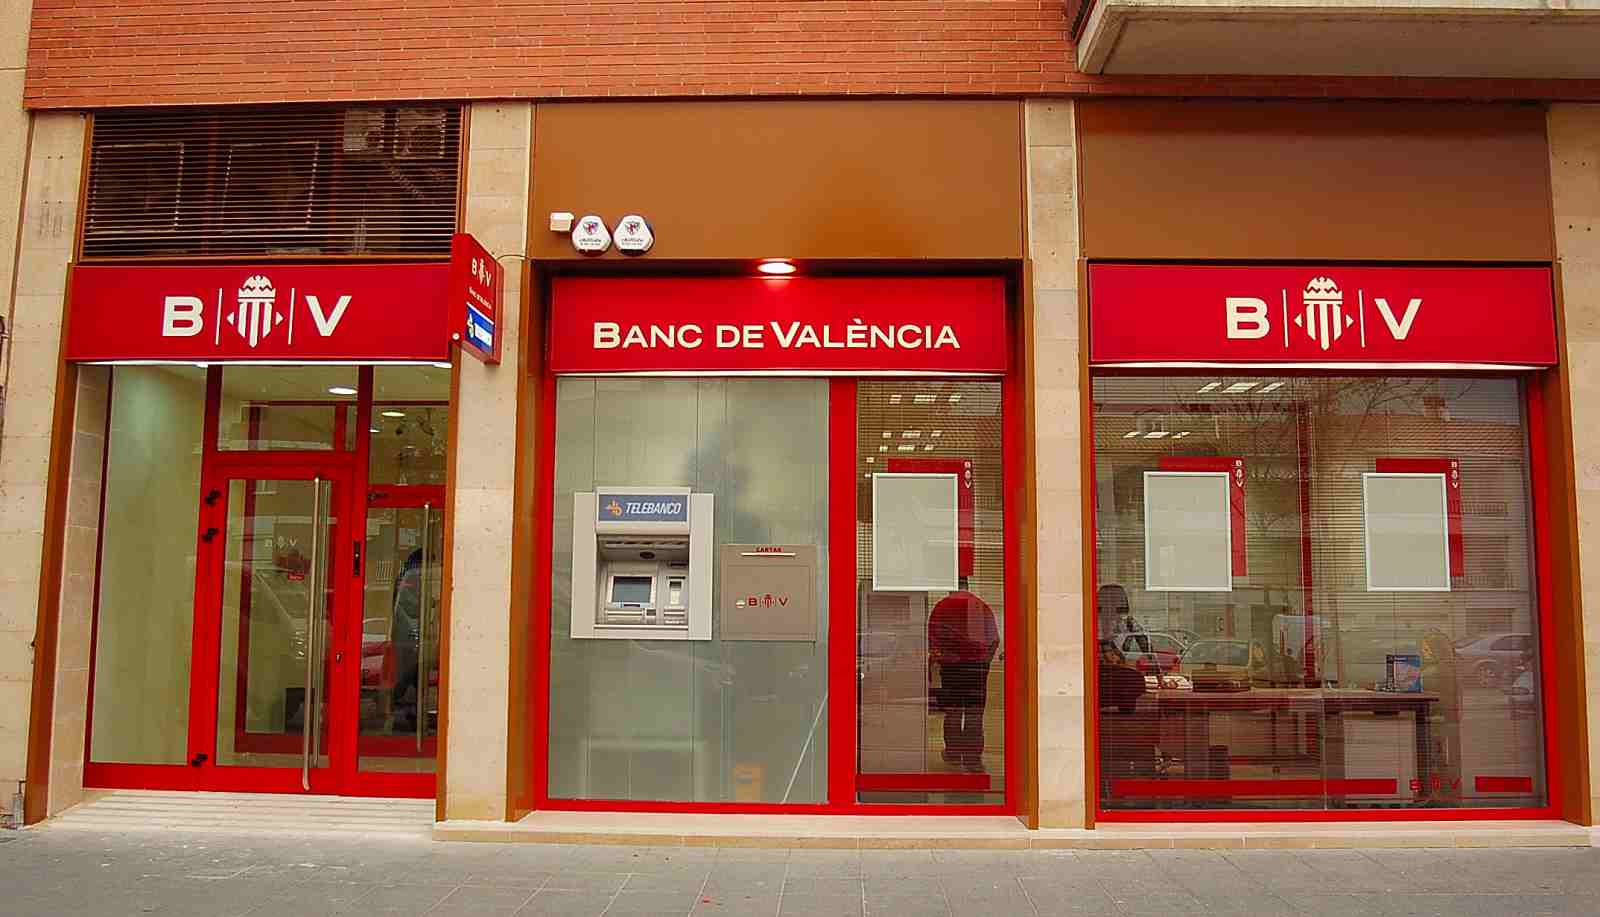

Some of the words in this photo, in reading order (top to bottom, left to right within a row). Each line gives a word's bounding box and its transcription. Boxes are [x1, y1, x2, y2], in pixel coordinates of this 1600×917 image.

[472, 258, 478, 276] B
[162, 296, 204, 337] B
[305, 295, 353, 337] V
[1225, 297, 1271, 339] B
[1374, 298, 1423, 340] V
[593, 322, 703, 349] BANC
[716, 325, 765, 349] DE
[770, 318, 961, 349] VALÈNCIA
[625, 502, 682, 515] TELEBANCO
[748, 597, 758, 607] B
[778, 597, 789, 607] V
